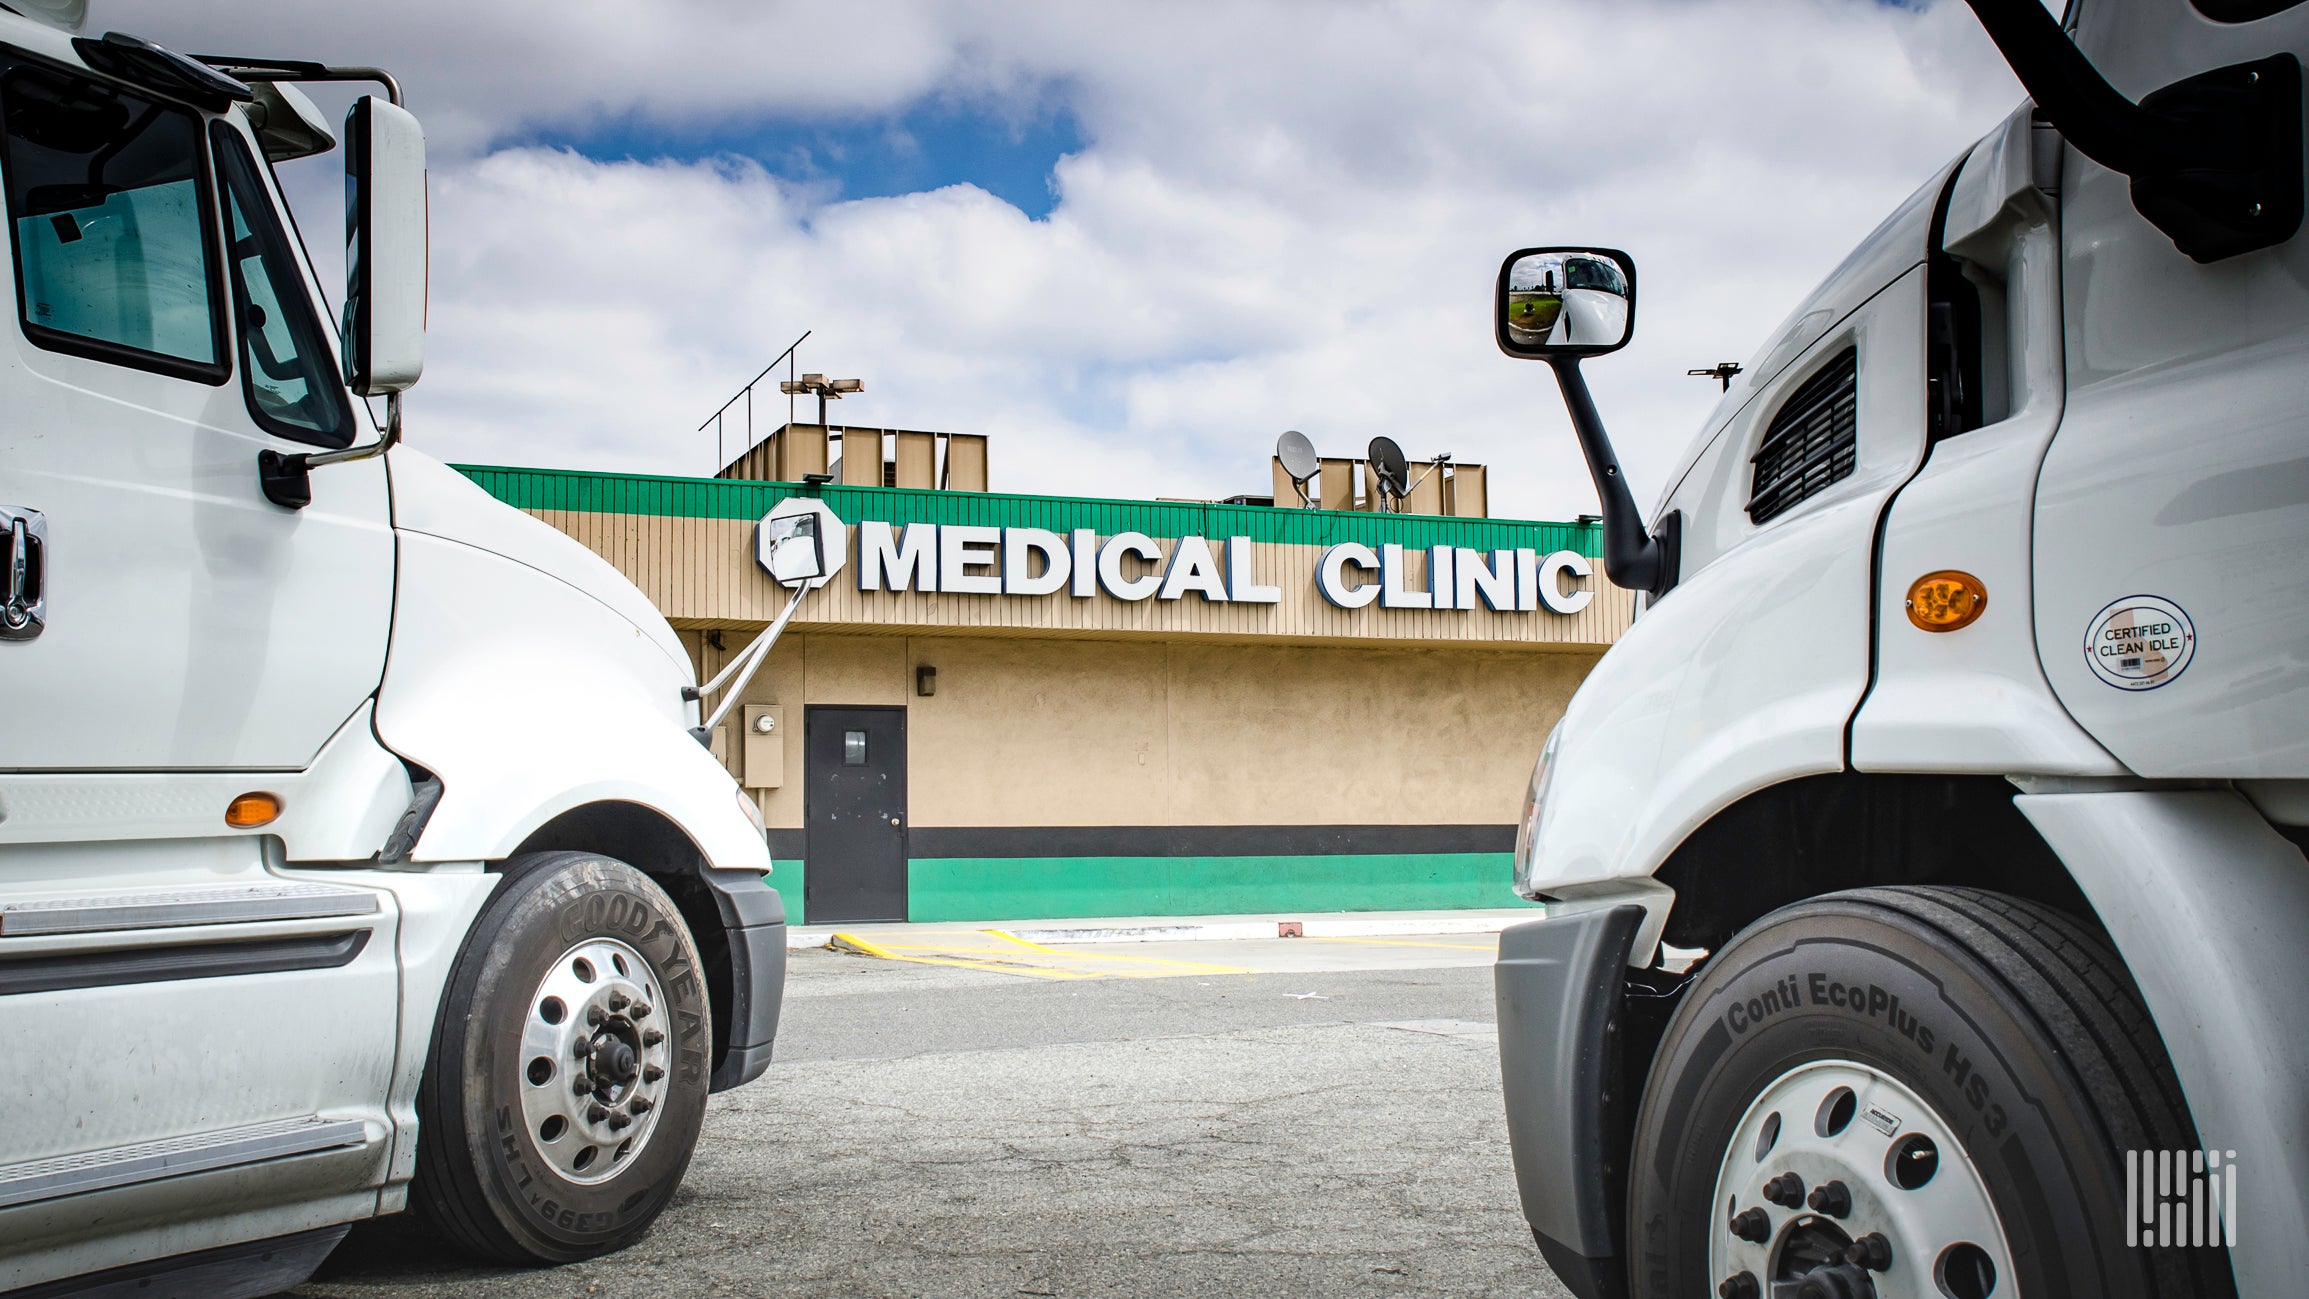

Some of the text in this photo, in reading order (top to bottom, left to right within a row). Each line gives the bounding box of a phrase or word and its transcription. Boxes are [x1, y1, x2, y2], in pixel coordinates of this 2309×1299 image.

[857, 521, 1594, 615] MEDICAL CLINIC
[2100, 637, 2179, 657] CLEAN IDLE
[2105, 623, 2171, 640] CERTIFIED
[1726, 973, 1801, 1034] Conti
[1808, 972, 1934, 1054] EcoPlus
[1943, 1042, 2008, 1138] HS3
